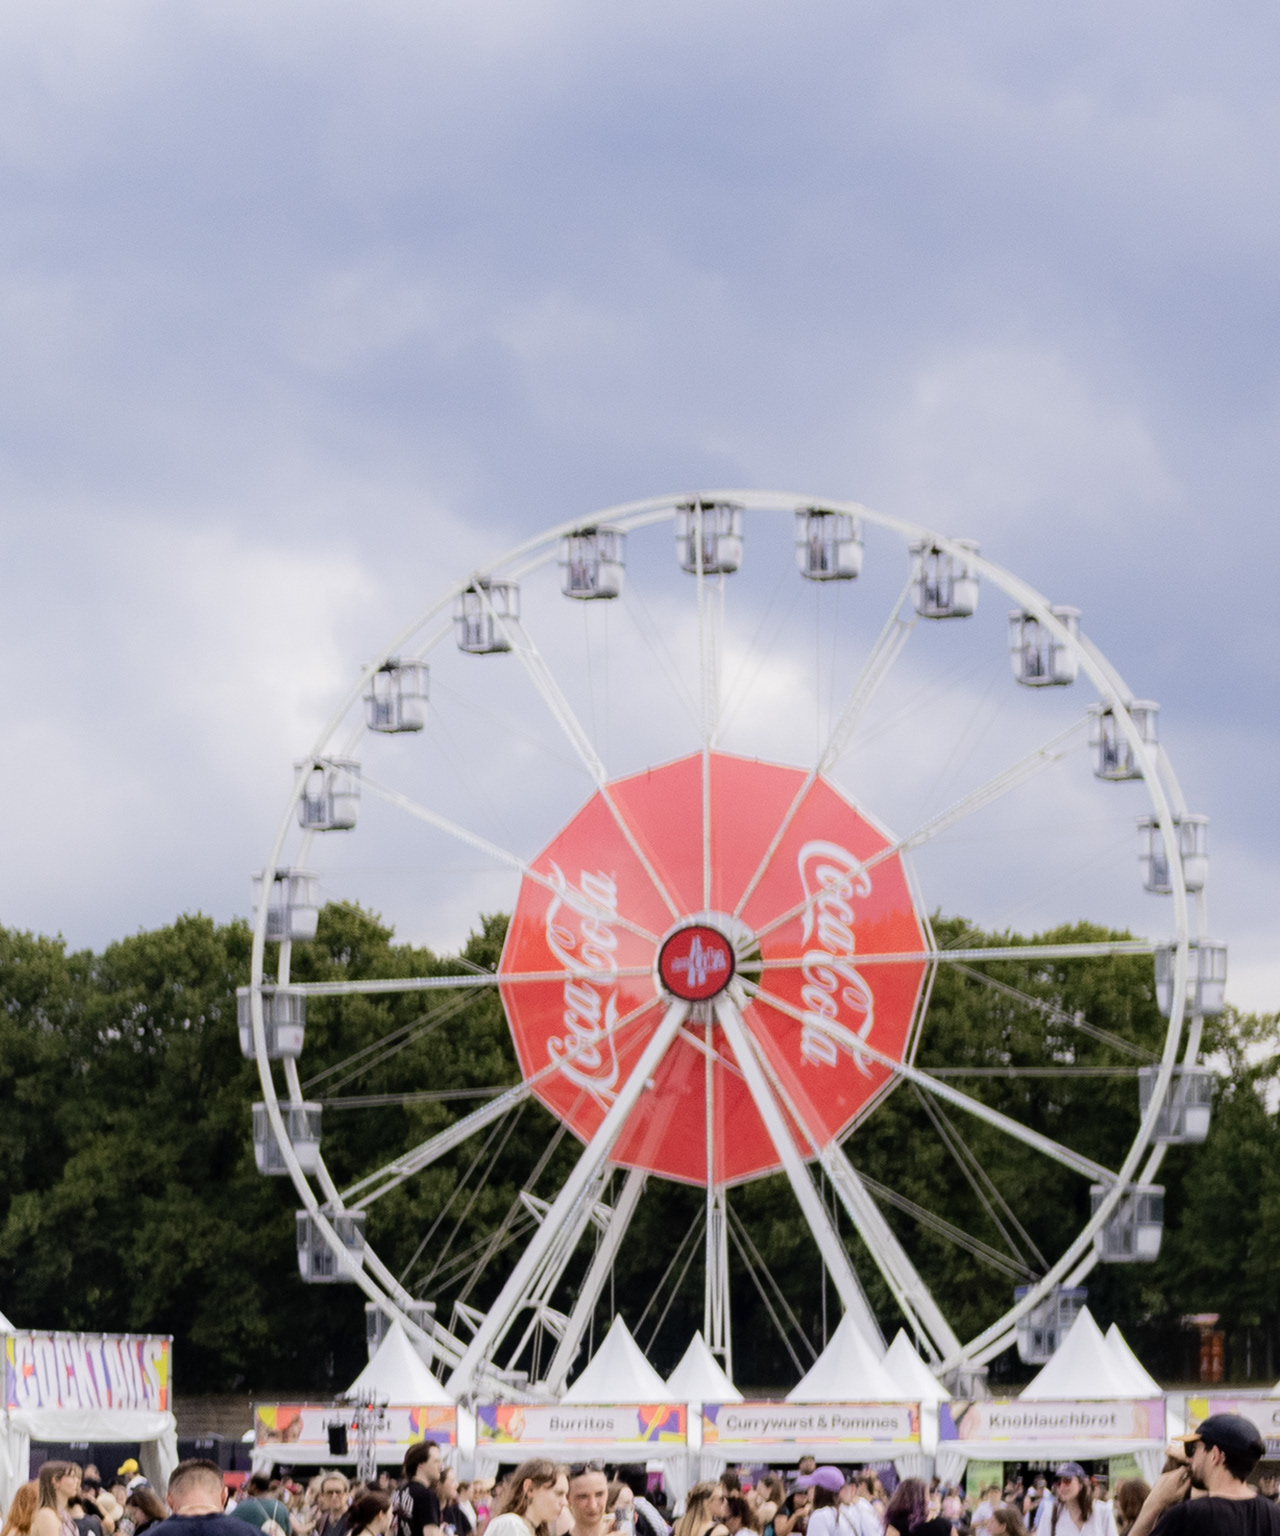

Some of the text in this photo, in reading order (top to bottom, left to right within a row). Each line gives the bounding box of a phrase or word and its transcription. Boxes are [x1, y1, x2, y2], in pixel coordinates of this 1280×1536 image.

[13, 1336, 163, 1410] COCKTAILS
[549, 1416, 615, 1431] Burritos
[726, 1415, 814, 1434] Currywurst
[831, 1416, 899, 1430] Pommes
[989, 1412, 1117, 1428] Knoblauchbrot
